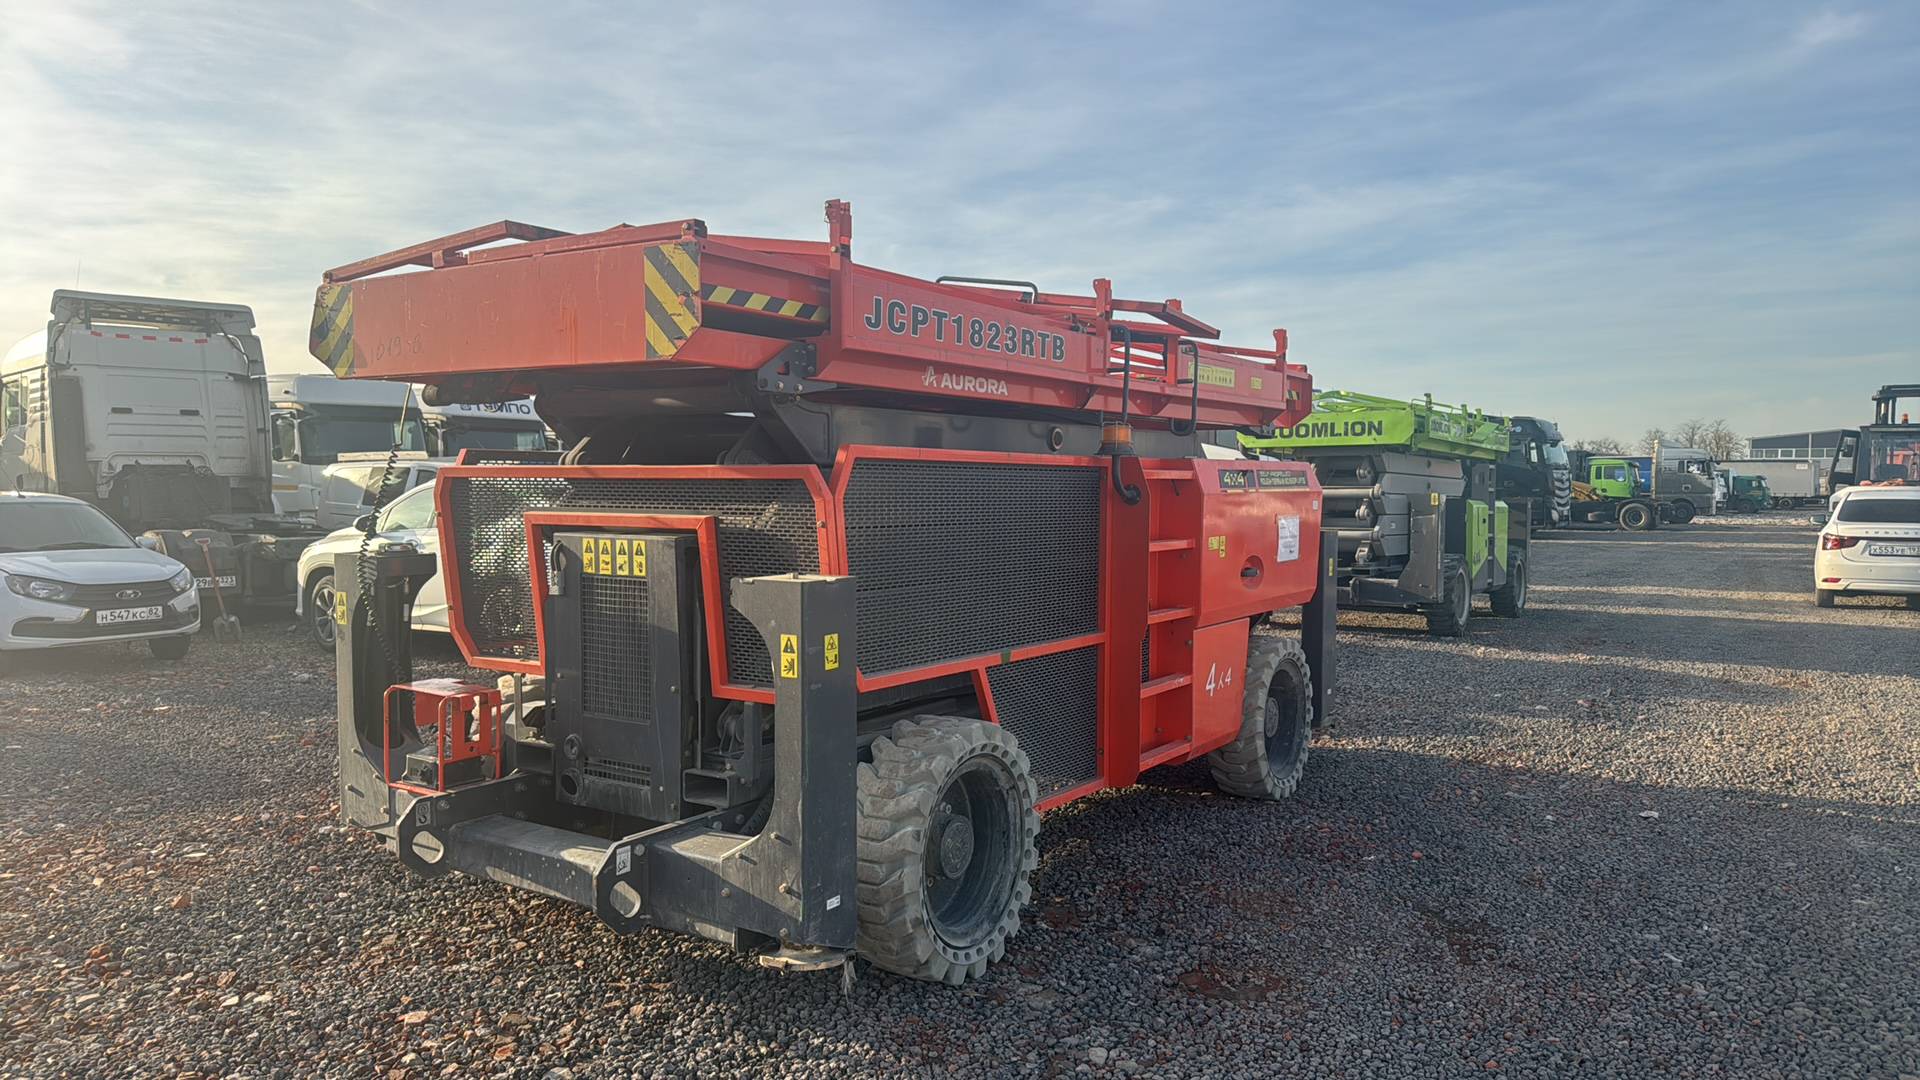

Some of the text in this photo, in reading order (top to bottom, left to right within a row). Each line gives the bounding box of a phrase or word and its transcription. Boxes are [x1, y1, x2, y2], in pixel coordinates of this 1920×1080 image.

[864, 296, 1066, 363] JCPT1823RTB
[941, 373, 1009, 396] AURORA
[1272, 420, 1383, 439] OOMLION
[148, 607, 159, 617] 82
